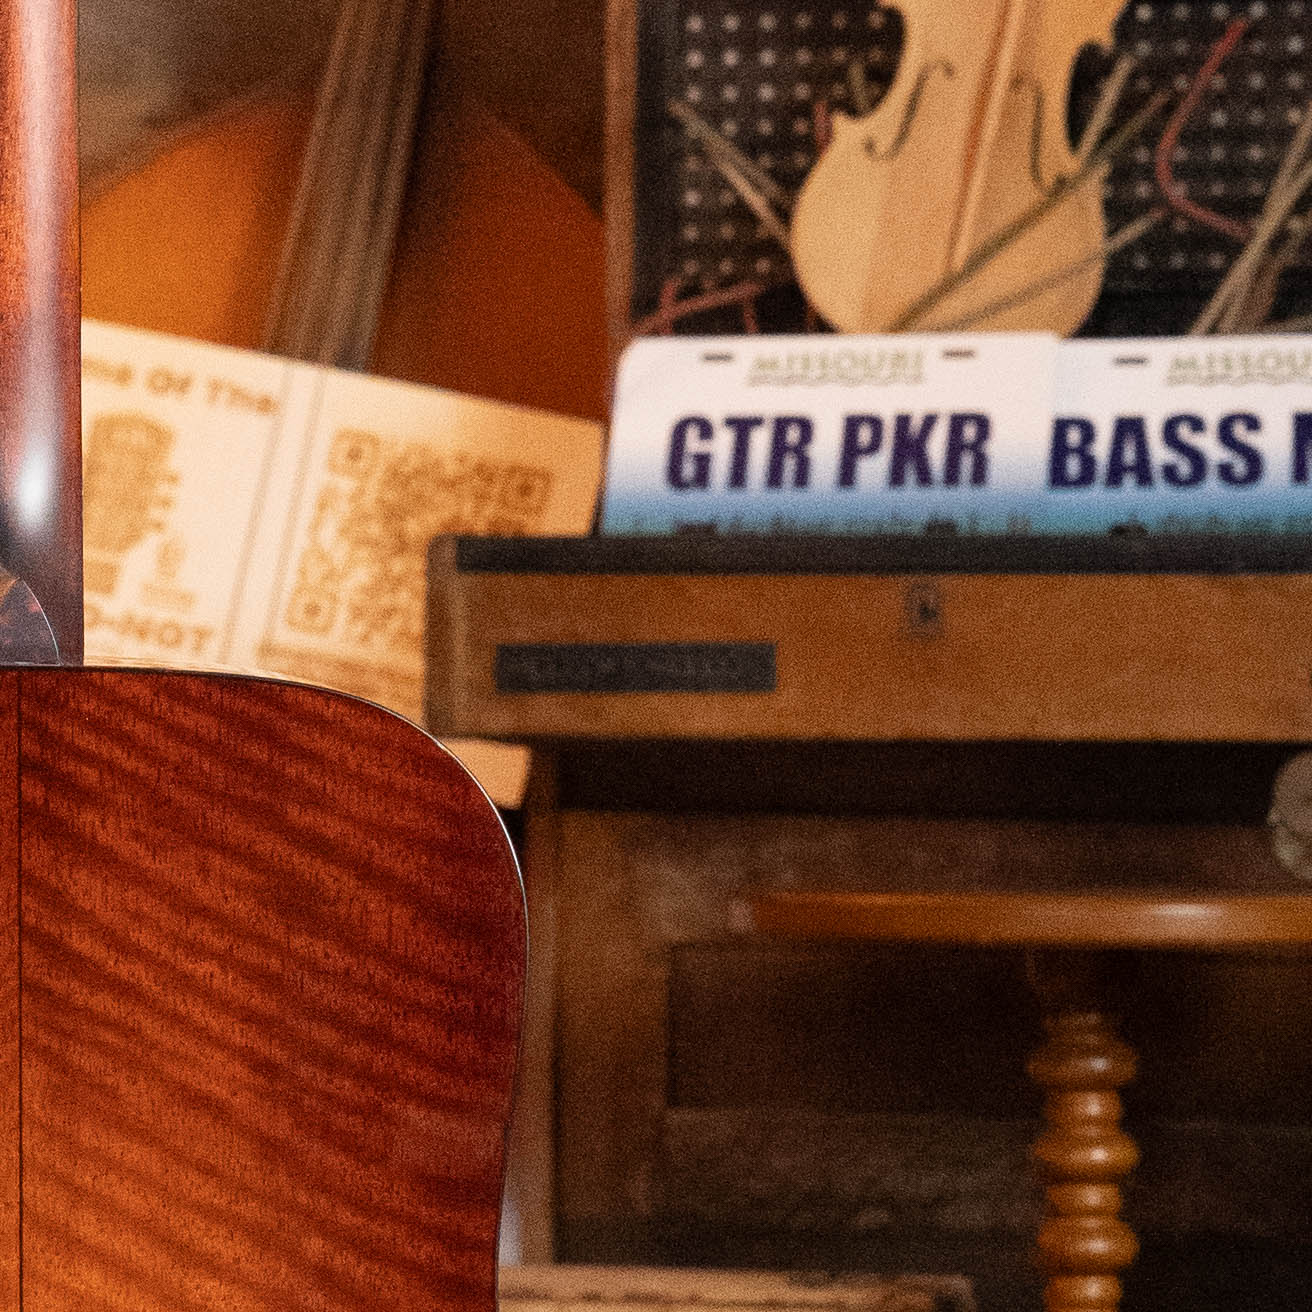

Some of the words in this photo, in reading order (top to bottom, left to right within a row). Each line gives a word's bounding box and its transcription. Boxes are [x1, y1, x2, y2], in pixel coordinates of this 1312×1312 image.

[665, 414, 815, 491] GTR
[836, 410, 993, 490] PKR
[1047, 411, 1266, 491] BASS
